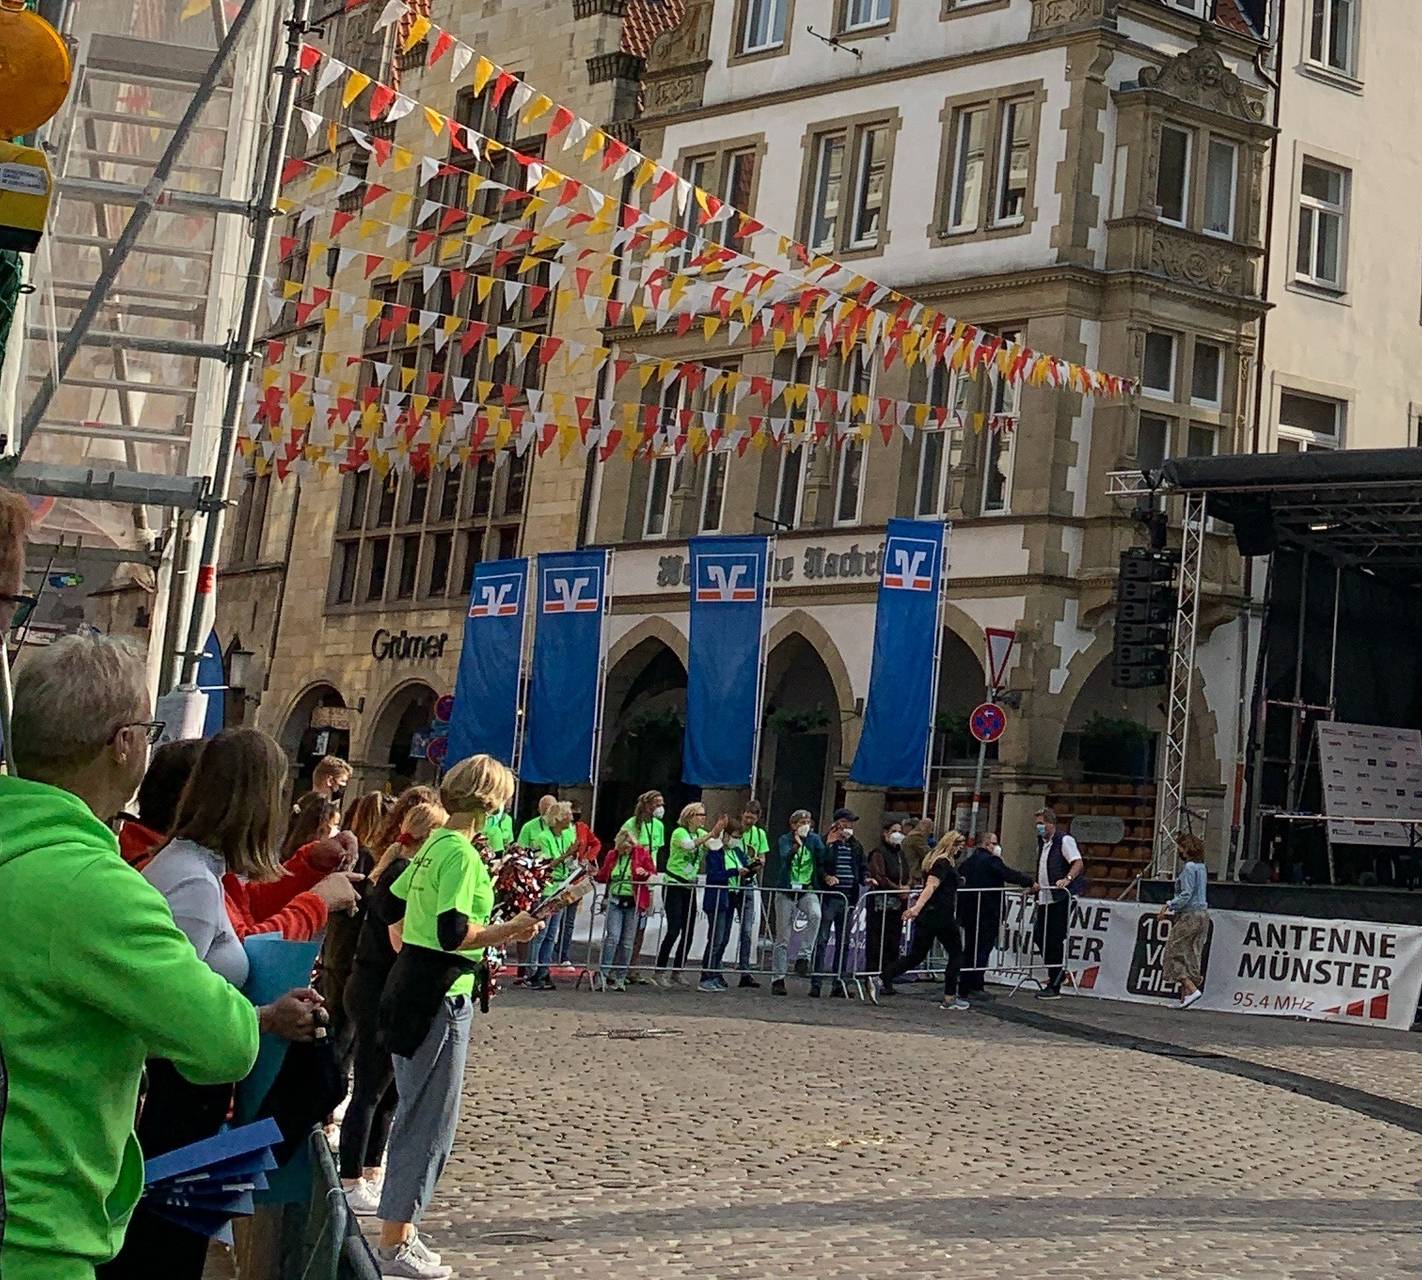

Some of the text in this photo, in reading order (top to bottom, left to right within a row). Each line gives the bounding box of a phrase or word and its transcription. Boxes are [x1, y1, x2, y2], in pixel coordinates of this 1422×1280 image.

[1243, 921, 1397, 960] ANTENNE
[1238, 951, 1393, 991] MÜNSTER
[1233, 991, 1315, 1012] 95.4 MHz
